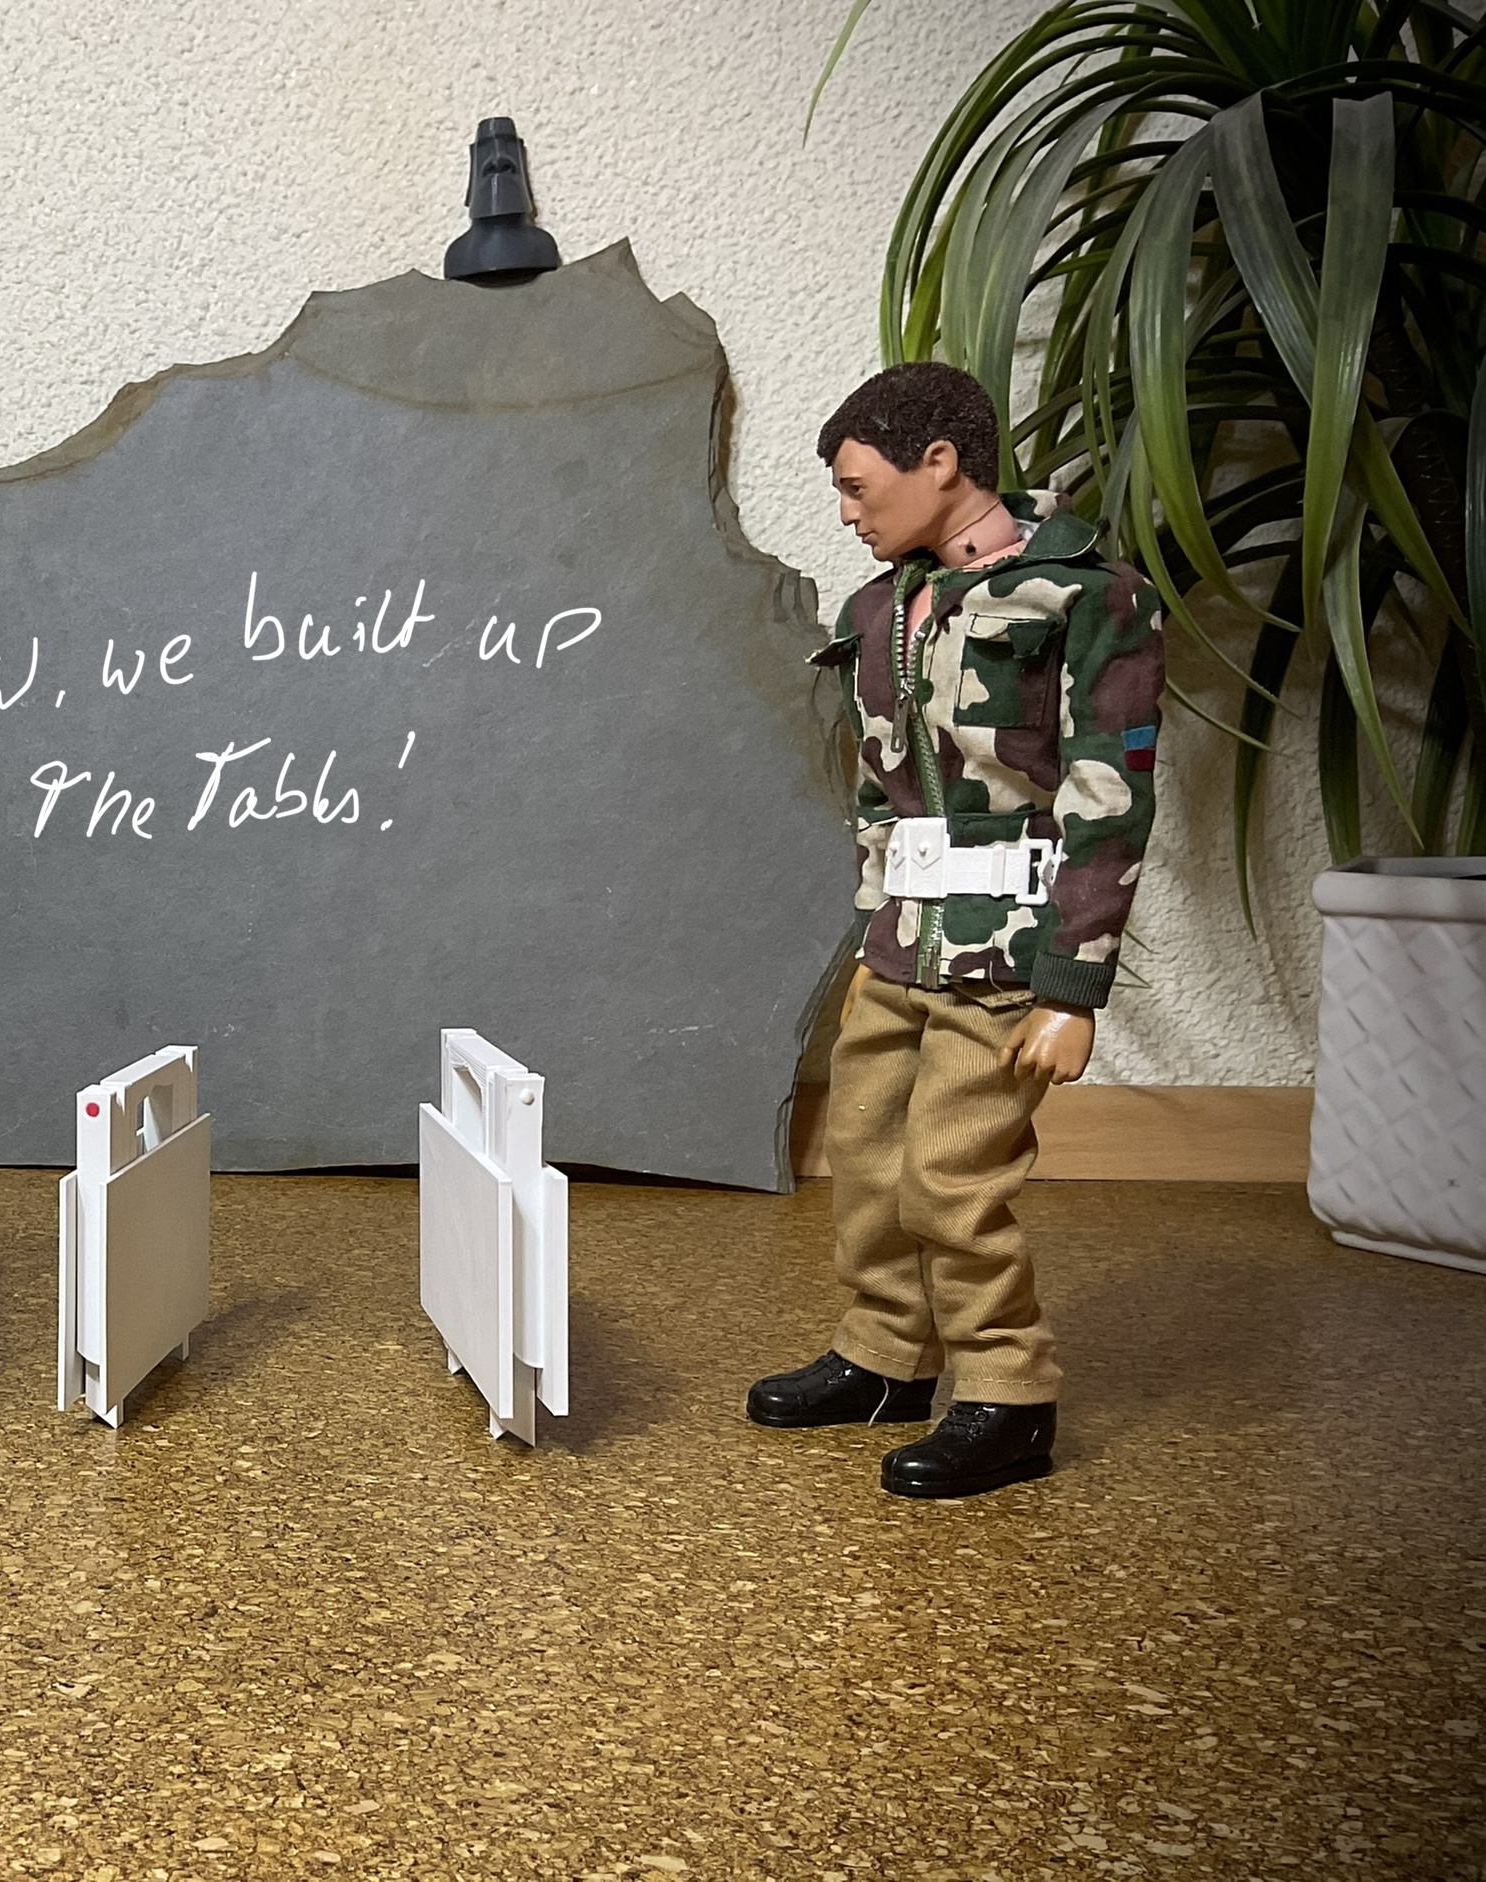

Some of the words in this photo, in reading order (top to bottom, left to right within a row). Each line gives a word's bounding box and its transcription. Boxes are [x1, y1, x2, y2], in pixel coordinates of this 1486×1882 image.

[102, 634, 194, 695] we
[244, 571, 435, 661] built
[479, 607, 602, 669] up
